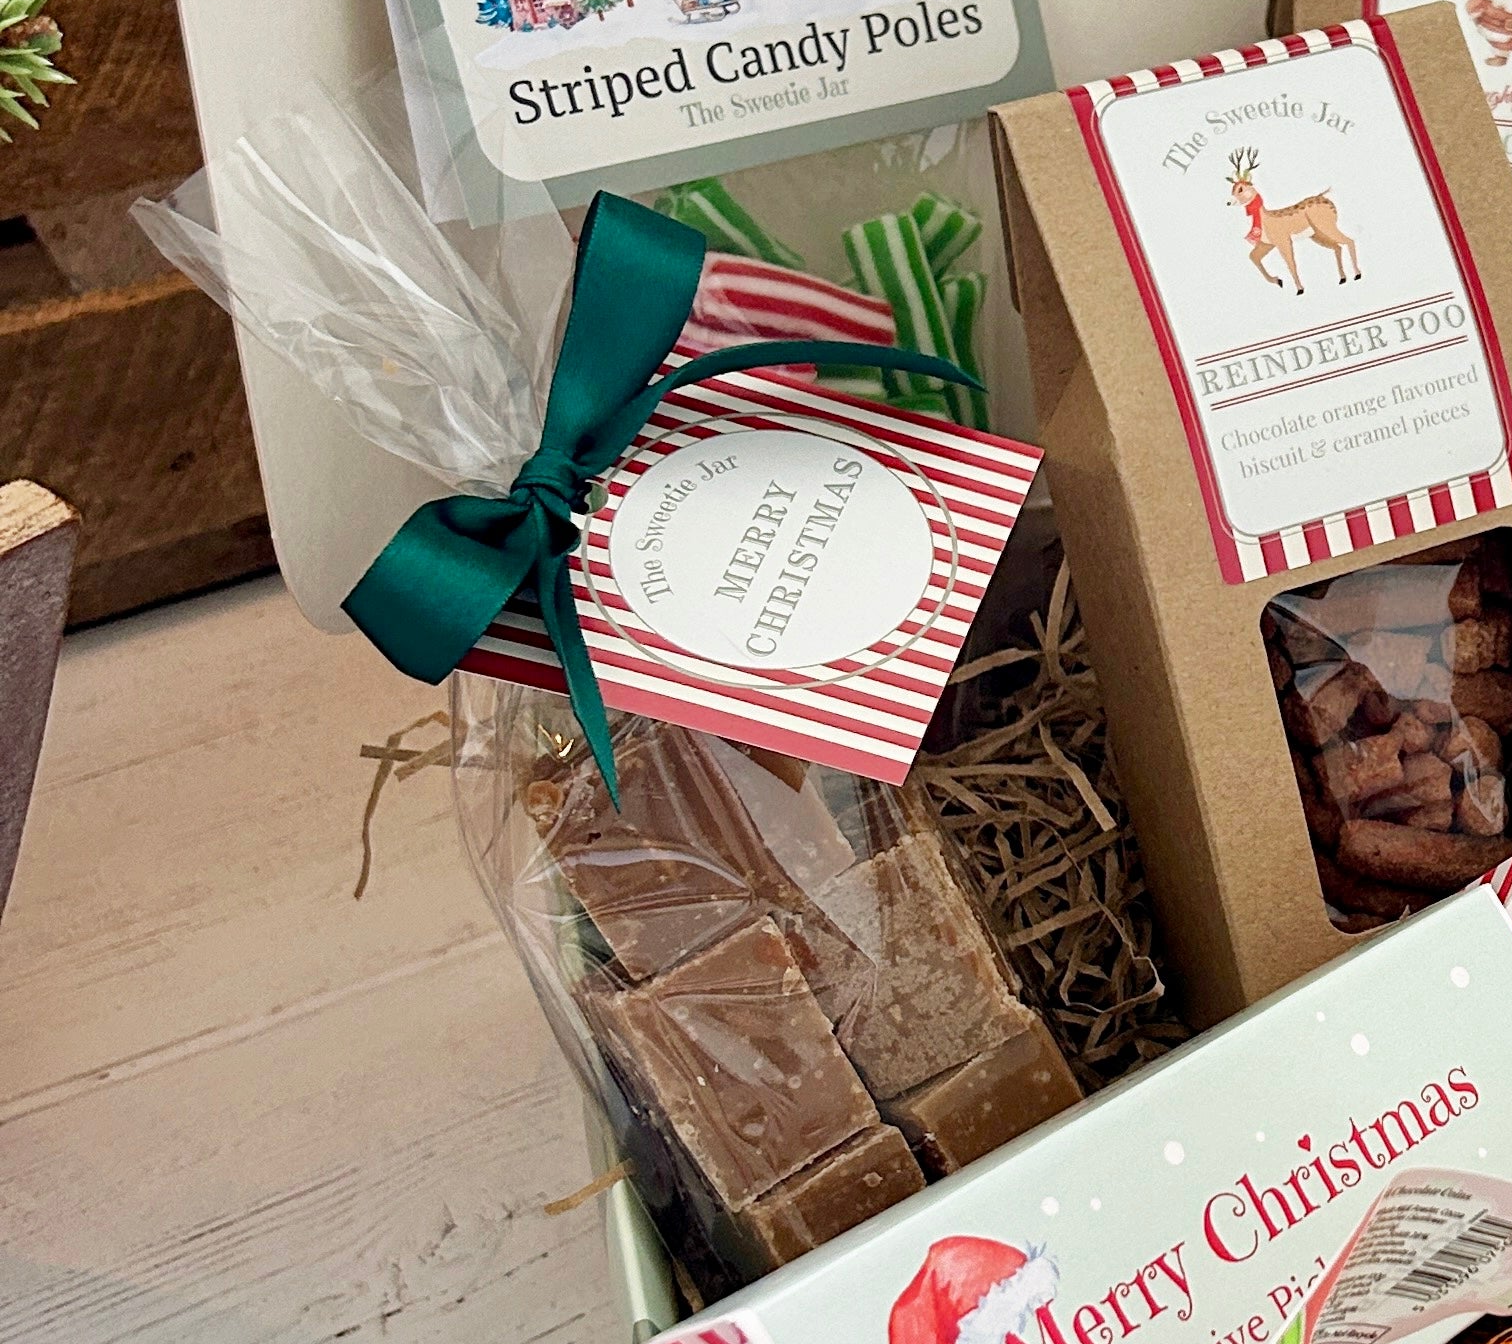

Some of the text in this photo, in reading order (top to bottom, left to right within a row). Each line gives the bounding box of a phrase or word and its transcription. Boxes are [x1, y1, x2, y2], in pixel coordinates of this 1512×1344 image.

[509, 4, 983, 125] Striped Candy Poles
[680, 75, 849, 129] The Sweetie Jar
[1162, 93, 1355, 175] The Sweetie Jar
[1197, 304, 1467, 397] REINDEER POO
[1221, 366, 1479, 453] Chocolate orange flavoured
[1240, 402, 1470, 479] biscuit & caramel pieces
[635, 456, 739, 604] The Sweetie Jar
[715, 479, 798, 602] MERRY
[745, 457, 863, 657] CHRISTMAS
[1203, 1066, 1479, 1264] Christmas
